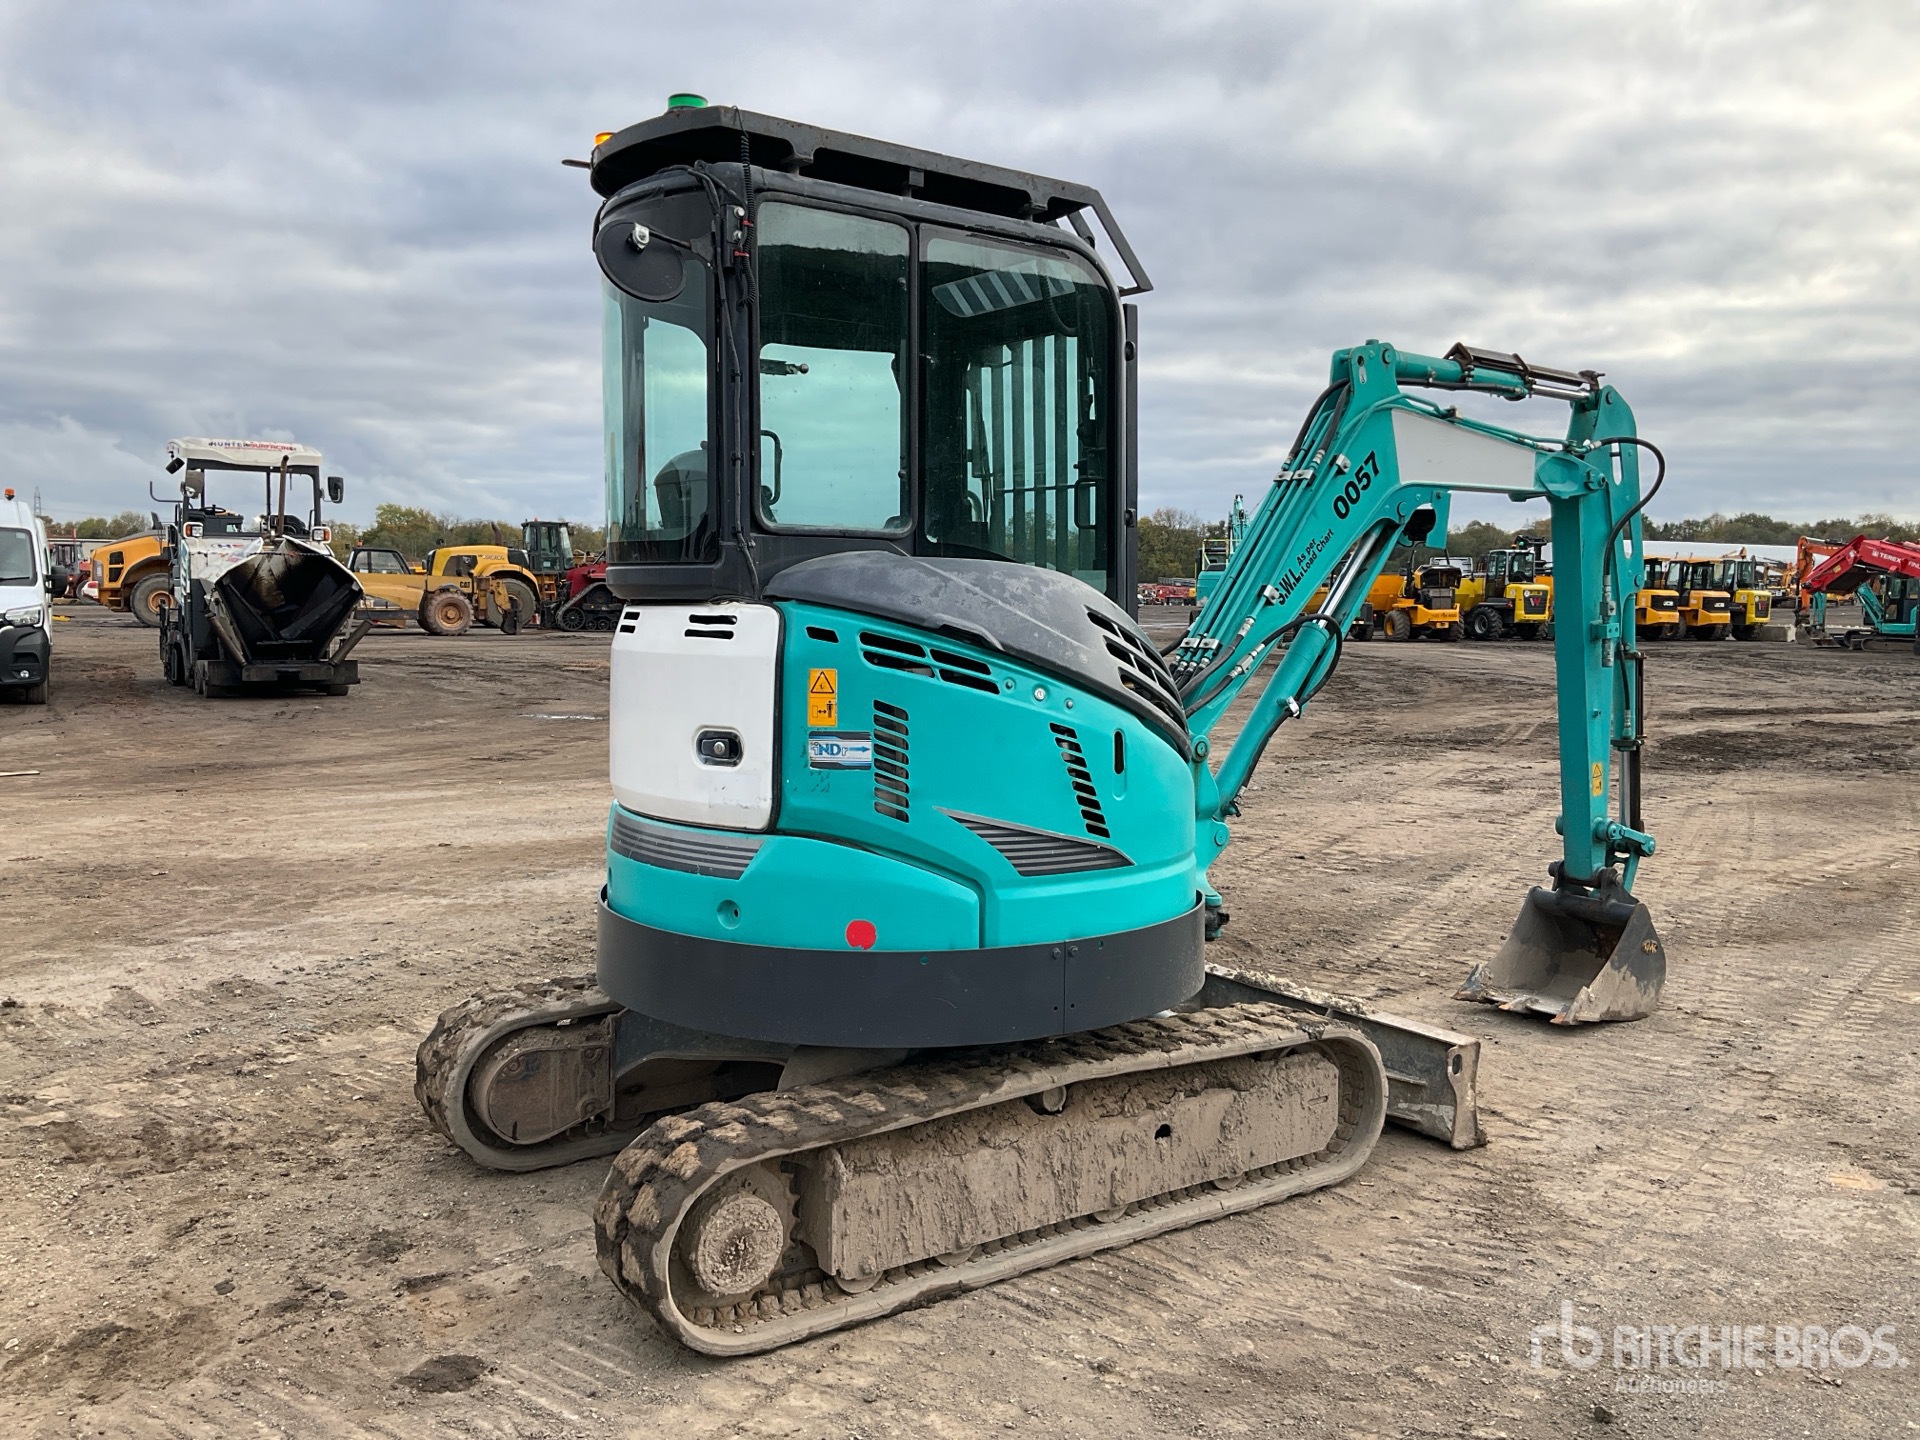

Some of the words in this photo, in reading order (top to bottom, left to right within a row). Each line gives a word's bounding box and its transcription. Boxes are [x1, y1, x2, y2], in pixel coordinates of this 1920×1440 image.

[1332, 449, 1380, 519] 0057
[1296, 552, 1307, 567] As
[1305, 537, 1317, 556] per
[1300, 550, 1317, 573] Load
[1315, 528, 1334, 552] Chart
[1879, 552, 1901, 564] TEREX
